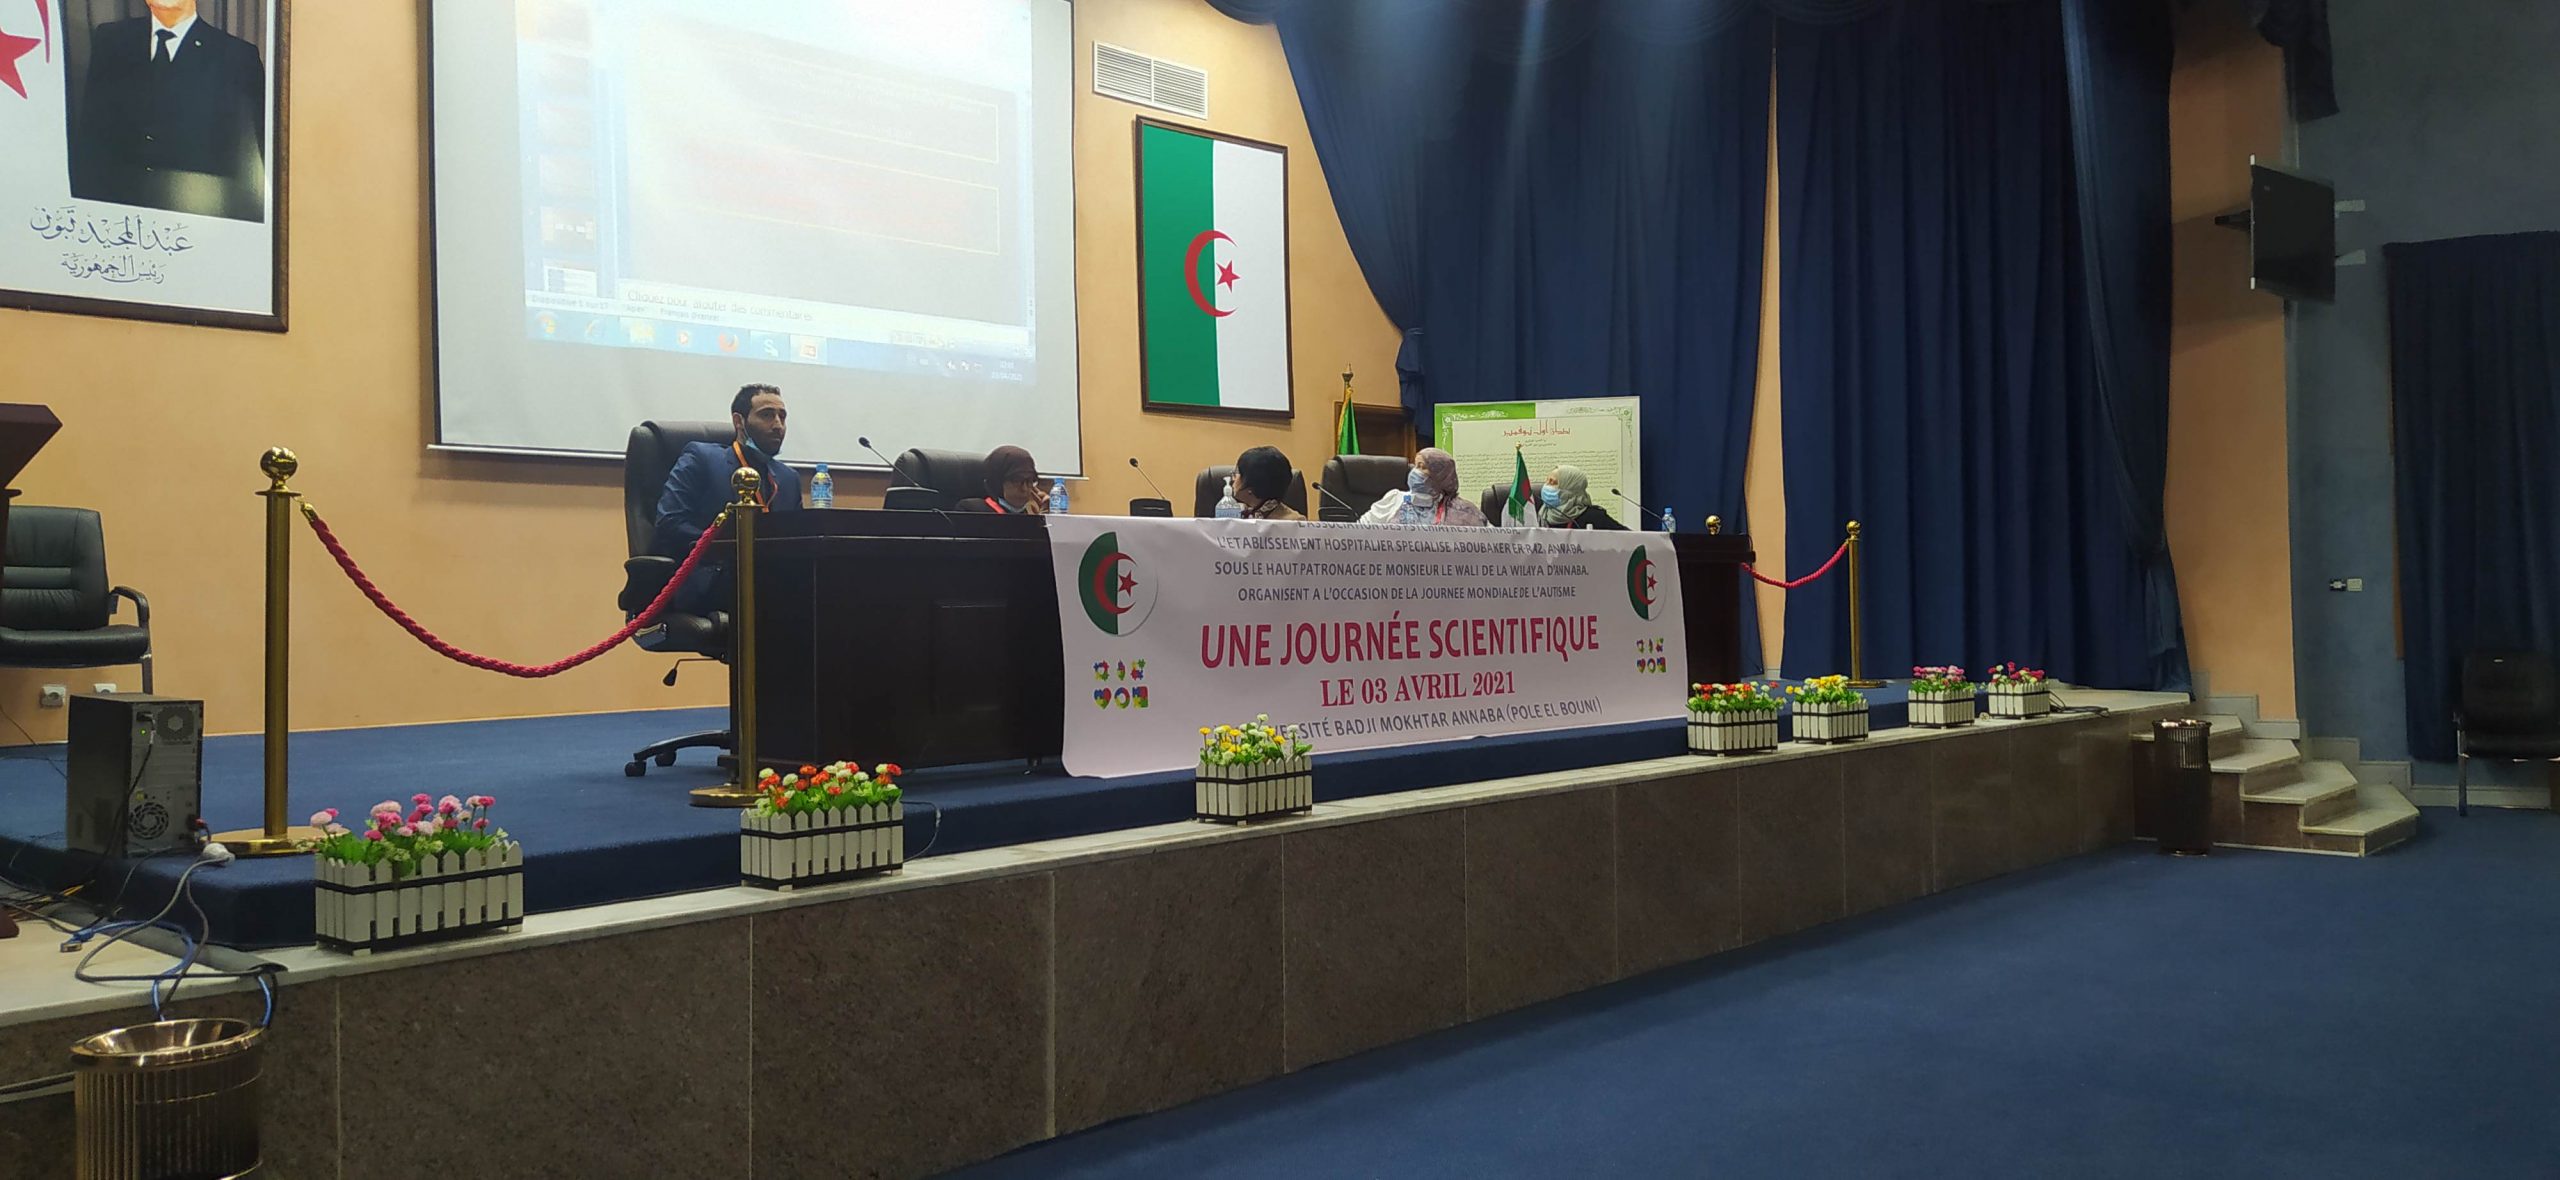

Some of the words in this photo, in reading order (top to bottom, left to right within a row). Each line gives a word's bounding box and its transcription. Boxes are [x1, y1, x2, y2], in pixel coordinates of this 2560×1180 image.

[1217, 536, 1322, 551] L'ETABLISSEMENT
[1325, 538, 1394, 552] HOSPITALIER
[1396, 541, 1451, 553] SPECIALISE
[1453, 542, 1511, 554] ABOUBAKER
[1215, 561, 1250, 575] SOUS
[1252, 563, 1263, 575] LE
[1266, 563, 1299, 575] HAUT
[1300, 563, 1366, 576] PATRONAGE
[1369, 564, 1382, 576] DE
[1385, 564, 1440, 576] MONSIEUR
[1442, 565, 1453, 576] LE
[1455, 565, 1479, 576] WALI
[1482, 565, 1495, 576] DE
[1496, 565, 1508, 576] LA
[1510, 565, 1545, 576] WILAYA
[1238, 587, 1310, 601] ORGANISENT
[1313, 588, 1321, 600] A
[1323, 587, 1389, 600] L'OCCASION
[1391, 587, 1403, 600] DE
[1405, 587, 1418, 600] LA
[1420, 587, 1465, 600] JOURNEE
[1467, 587, 1518, 599] MONDIALE
[1519, 587, 1529, 598] DE
[1532, 586, 1577, 598] L'AUTISME
[1201, 624, 1272, 669] UNE
[1279, 610, 1421, 666] JOURNÉE
[1429, 615, 1600, 663] SCIENTIFIQUE
[1320, 678, 1354, 707] LE
[1361, 677, 1388, 705] 03
[1395, 672, 1467, 702] AVRIL
[1472, 671, 1516, 697] 2021
[1335, 718, 1377, 736] BADJI
[1380, 712, 1450, 732] MOKHTAR
[1452, 705, 1506, 726] ANNABA
[1506, 703, 1543, 722] (POLE
[1545, 702, 1559, 717] EL
[1560, 696, 1604, 716] BOUNI)
